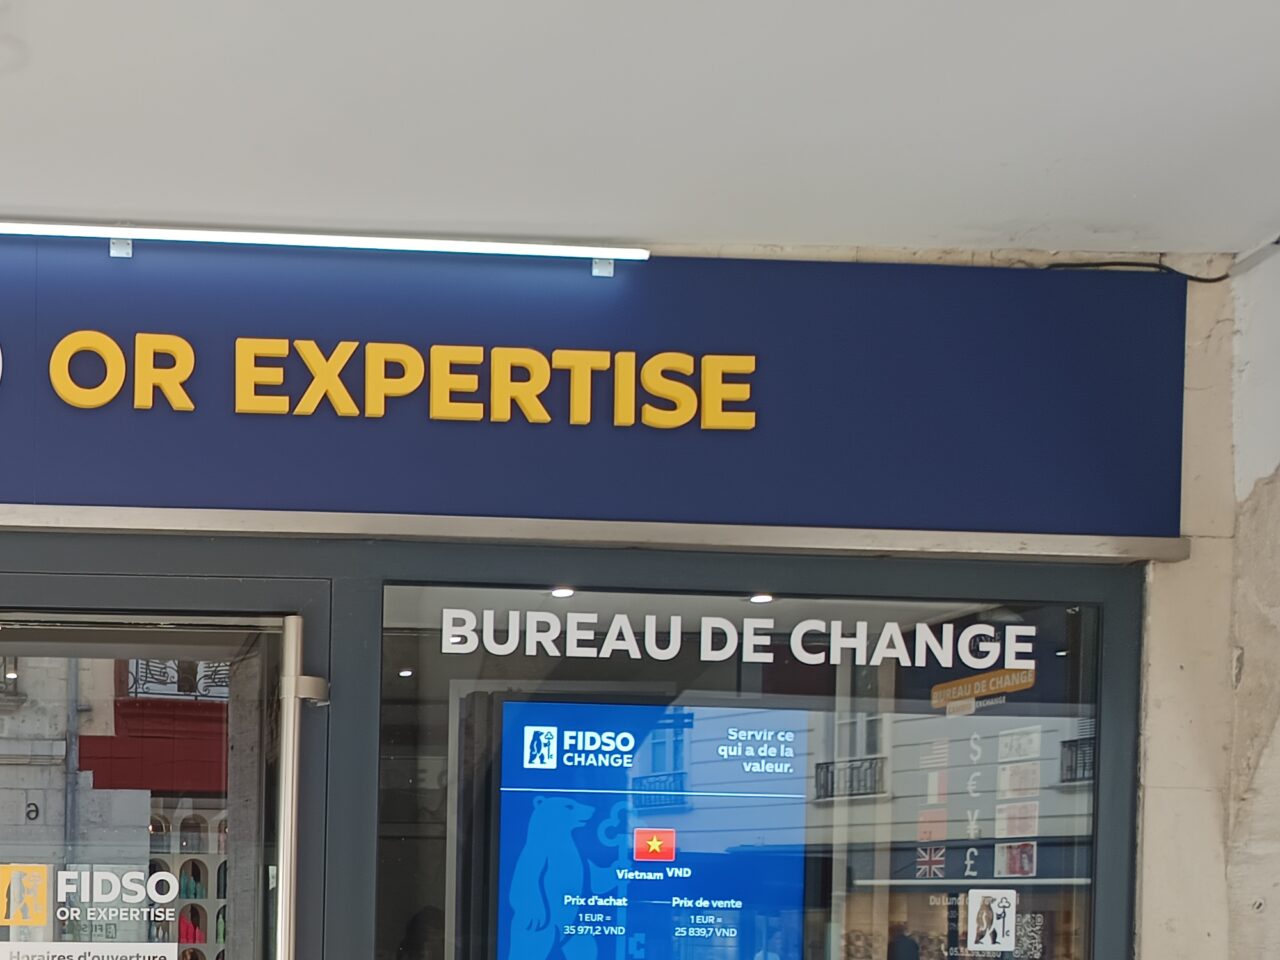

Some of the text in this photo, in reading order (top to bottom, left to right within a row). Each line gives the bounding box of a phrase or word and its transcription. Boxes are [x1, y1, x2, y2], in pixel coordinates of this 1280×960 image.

[48, 330, 197, 411] OR
[235, 337, 757, 430] EXPERTISE
[441, 608, 682, 660] BUREAU
[700, 616, 775, 663] DE
[790, 620, 1037, 670] CHANGE
[973, 680, 986, 694] DE
[727, 728, 794, 741] Servir ce
[563, 731, 635, 752] FIDSO
[718, 743, 794, 758] qui a de la
[563, 753, 633, 767] CHANGE
[742, 760, 794, 773] valeur.
[616, 867, 691, 880] Vietnam VND
[57, 871, 179, 903] FIDSO
[563, 895, 628, 907] Prix d'achat
[672, 897, 742, 908] Prix de vente
[56, 907, 176, 921] OR EXPERTISE
[584, 914, 603, 922] EUR
[696, 916, 715, 924] EUR
[603, 926, 625, 935] VND
[715, 928, 737, 937] VND
